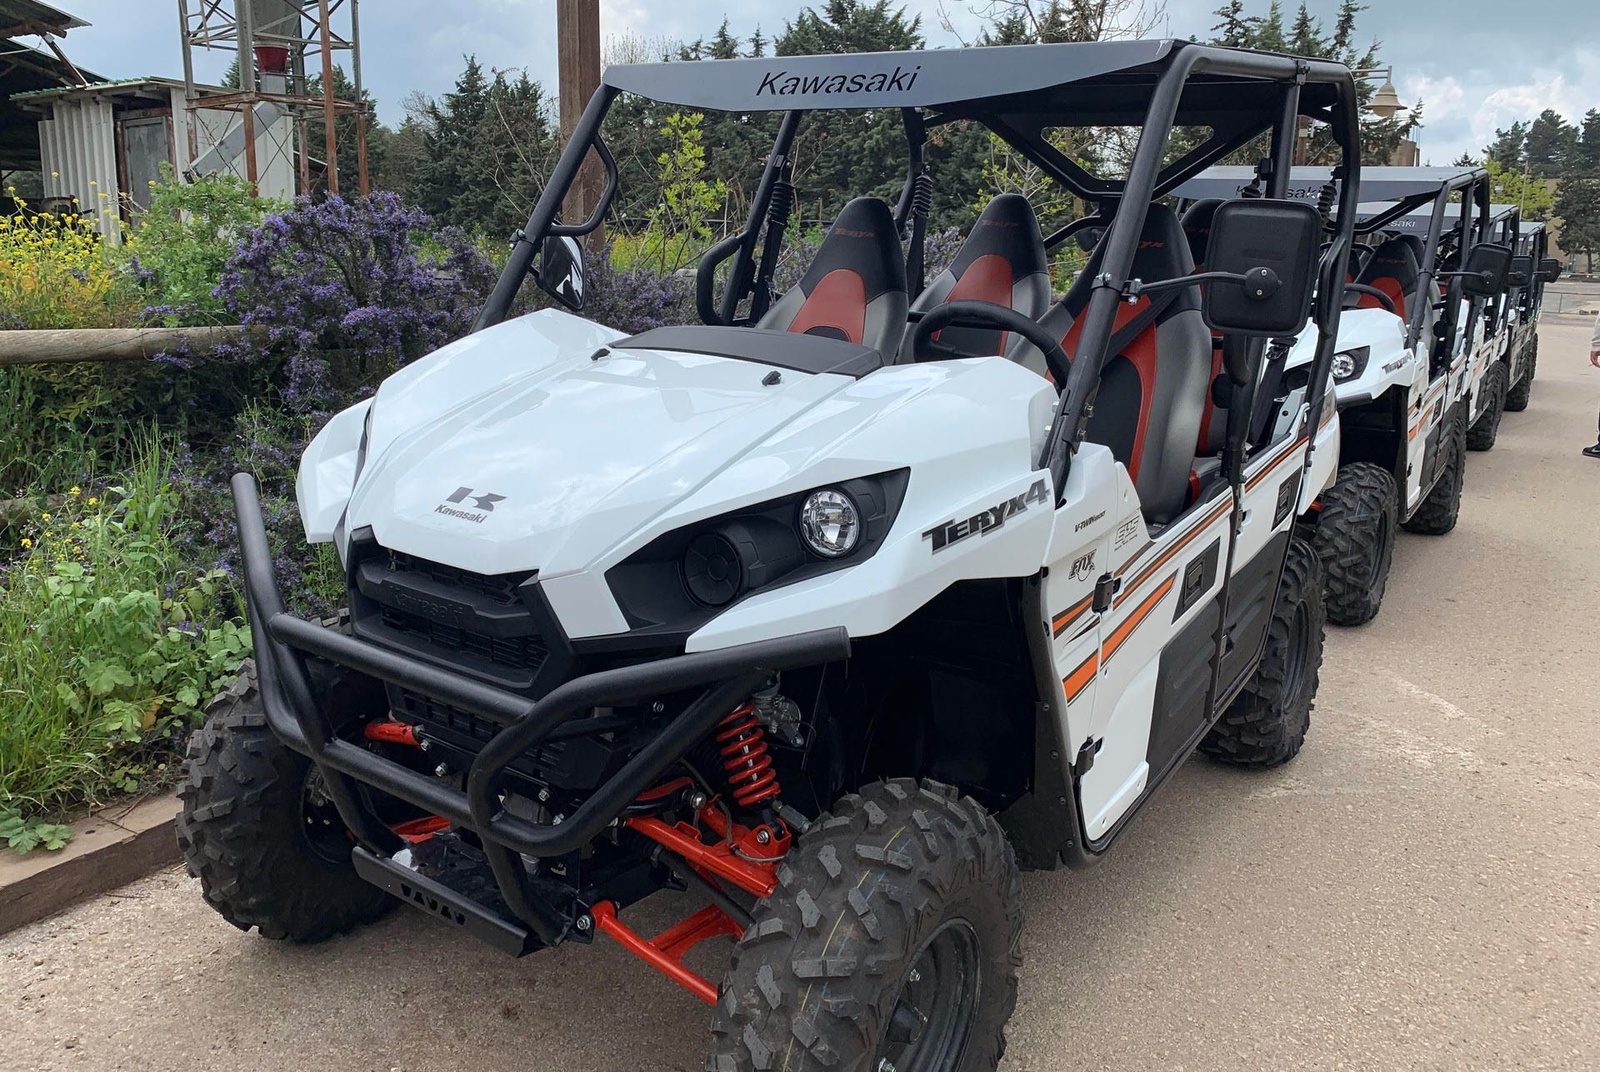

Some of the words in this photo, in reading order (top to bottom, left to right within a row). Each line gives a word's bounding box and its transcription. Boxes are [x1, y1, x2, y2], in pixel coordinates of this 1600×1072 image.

[755, 65, 922, 97] Kawasaki
[1235, 184, 1323, 199] Ksaki
[434, 504, 488, 524] Kawasaki
